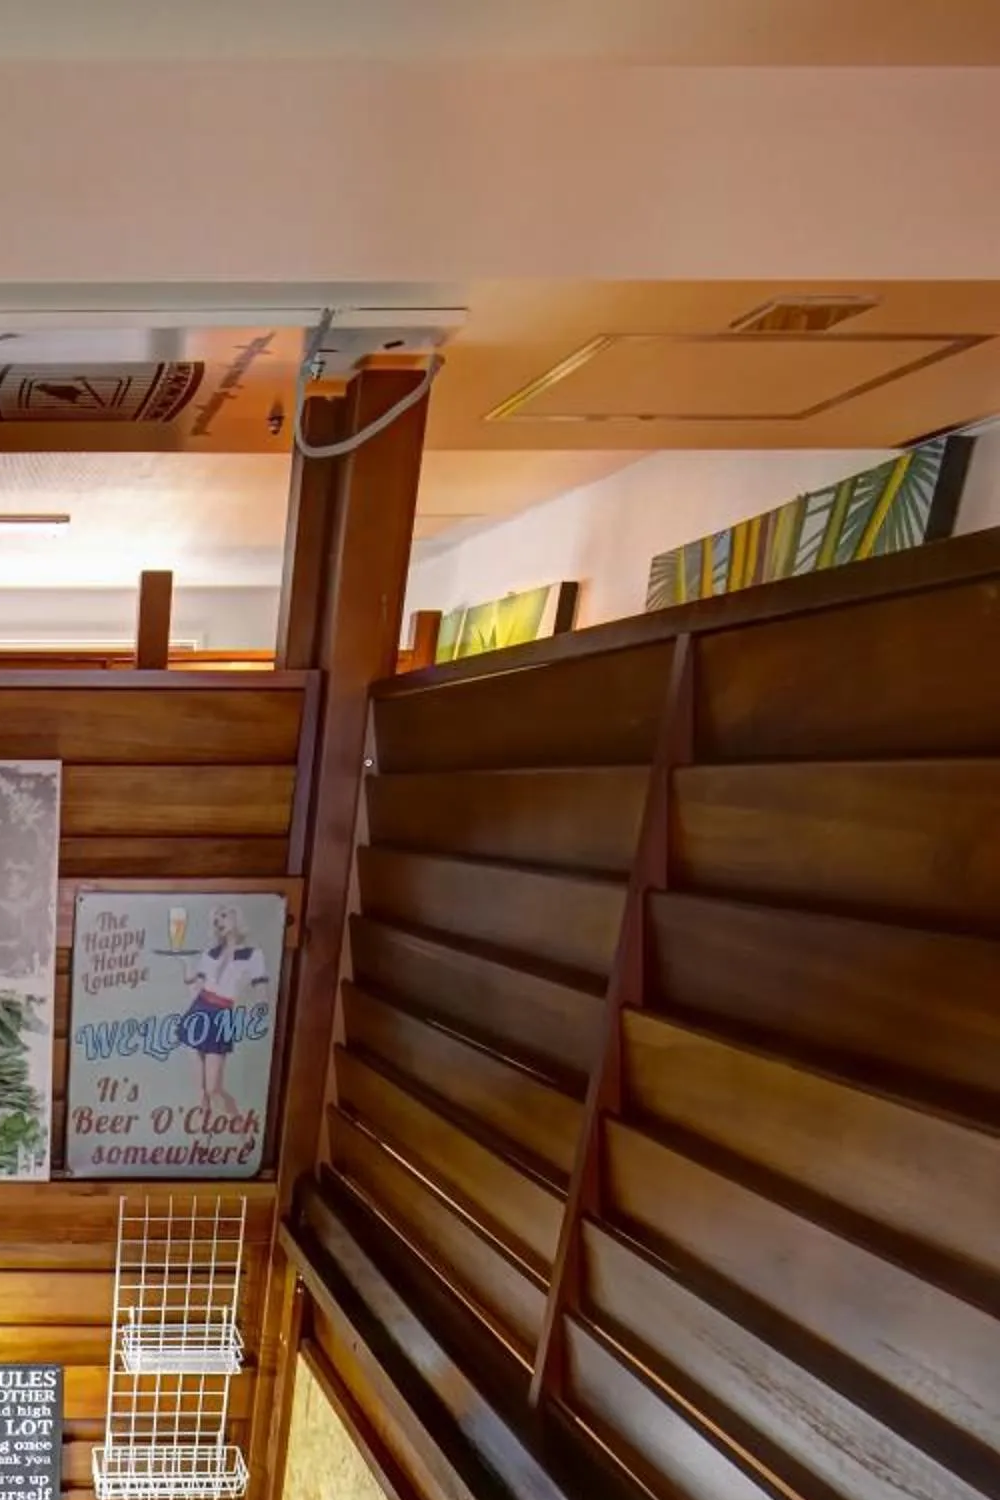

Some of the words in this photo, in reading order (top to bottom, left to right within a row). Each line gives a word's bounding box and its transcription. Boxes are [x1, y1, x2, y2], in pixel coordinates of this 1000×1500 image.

[97, 911, 128, 931] The
[82, 929, 146, 952] Happy
[92, 950, 139, 971] Hour
[82, 965, 149, 995] Lounge
[75, 1003, 270, 1062] WELCOME
[97, 1077, 139, 1102] It's
[72, 1106, 139, 1135] Beer
[152, 1106, 261, 1136] O'Clock
[91, 1141, 256, 1166] somewhere
[17, 1405, 51, 1418] high
[5, 1419, 53, 1436] LOT
[13, 1440, 52, 1451] once
[29, 1475, 49, 1487] up
